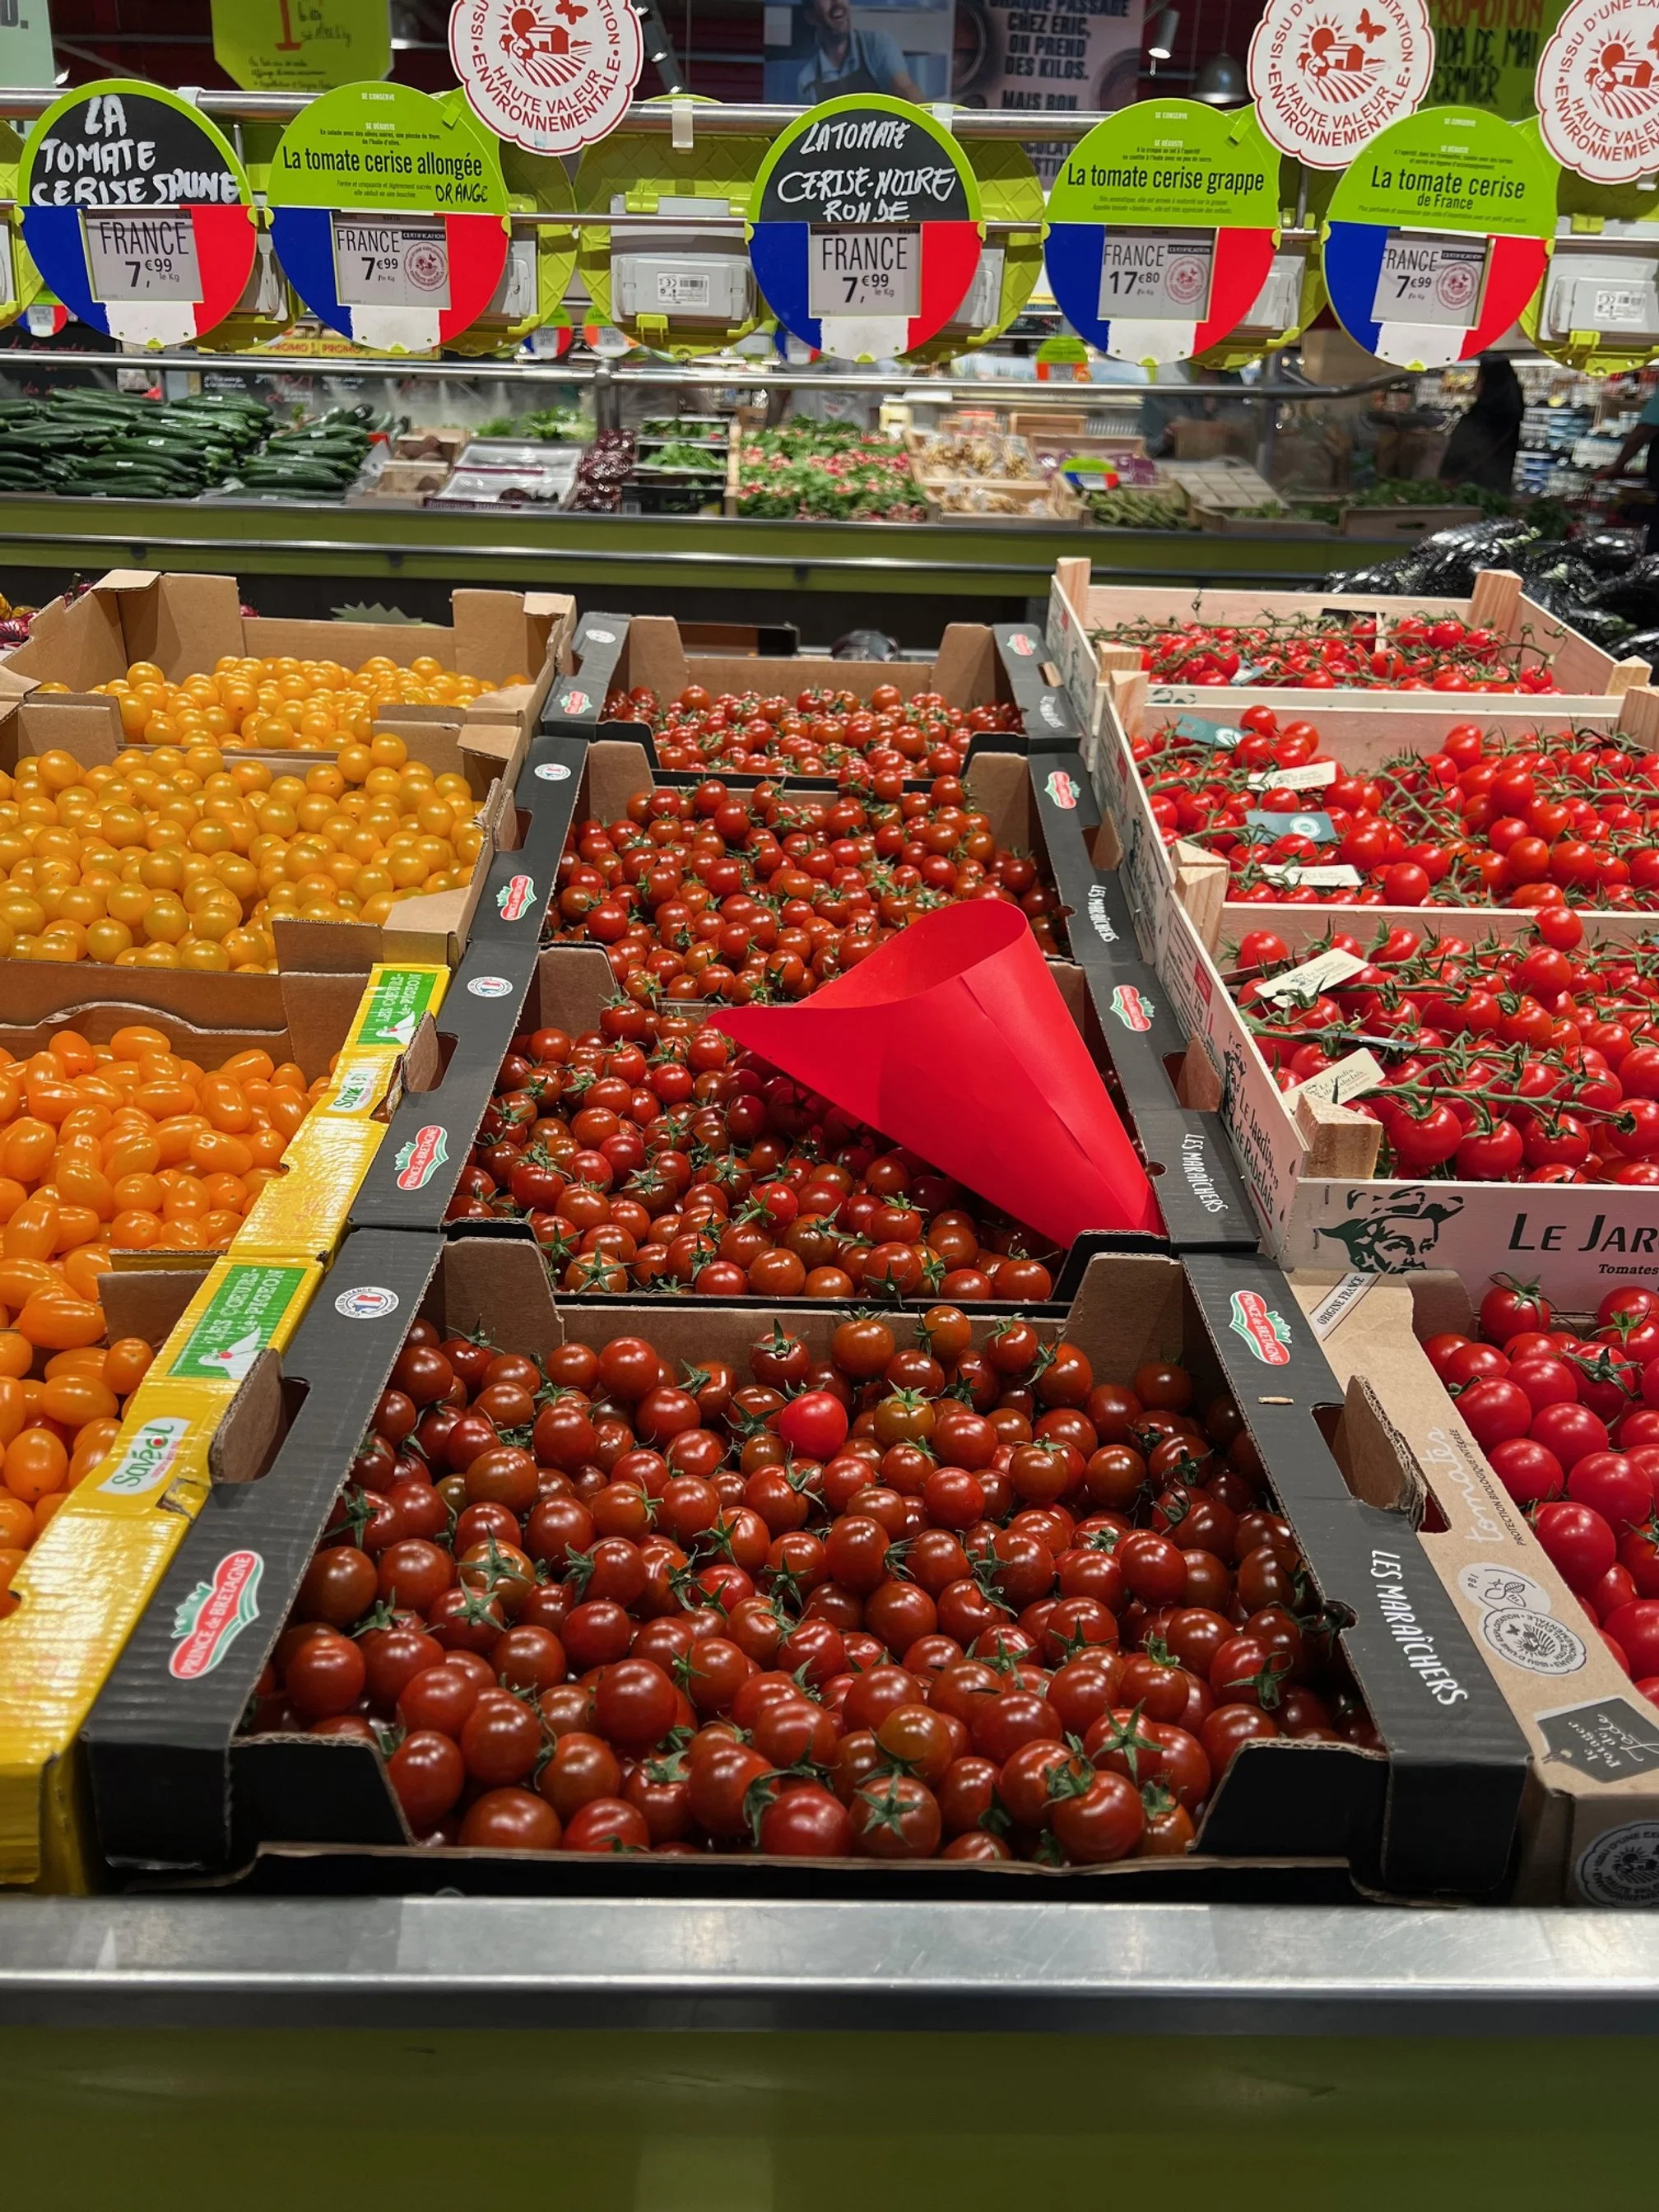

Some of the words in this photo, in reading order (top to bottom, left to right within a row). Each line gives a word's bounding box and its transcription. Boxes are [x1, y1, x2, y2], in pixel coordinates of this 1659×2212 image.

[1007, 12, 1047, 33] CHEZ
[1270, 17, 1293, 58] ISSU
[1010, 35, 1030, 53] ON
[1034, 36, 1086, 58] PREND
[1559, 32, 1585, 73] ISSU
[1006, 56, 1034, 76] DES
[1039, 58, 1089, 79] KILOS.
[472, 53, 621, 132] ENVIRONNEMENTALE
[493, 66, 541, 113] HAUTE
[546, 69, 602, 114] VALEUR
[1002, 91, 1041, 109] MAIS
[1286, 82, 1328, 128] HAUTE
[85, 95, 128, 137] LA
[1268, 71, 1411, 146] ENVIRONNEMENTALE
[1332, 86, 1390, 129] VALEUR
[1572, 97, 1611, 144] HAUTE
[40, 138, 156, 176] TOMATE
[283, 146, 301, 170] La
[305, 148, 360, 171] tomate
[365, 151, 412, 174] cerise
[417, 151, 482, 180] allongée
[32, 177, 147, 206] CERISE
[435, 183, 487, 204] ORANGE
[1067, 163, 1085, 185] La
[1091, 165, 1147, 187] tomate
[1153, 166, 1202, 189] cerise
[1206, 172, 1264, 196] grappe
[1371, 165, 1392, 188] La
[1399, 169, 1462, 194] tomate
[1469, 175, 1525, 199] cerise
[822, 199, 910, 222] RONDE
[1417, 193, 1430, 207] de
[1434, 193, 1473, 211] France
[100, 221, 188, 255] FRANCE
[337, 230, 400, 253] FRANCE
[823, 237, 907, 271] FRANCE
[1104, 244, 1165, 267] FRANCE
[1088, 885, 1107, 898] LES
[1181, 1133, 1205, 1150] LES
[1183, 1152, 1229, 1212] MARAÎCHERS
[1598, 1263, 1659, 1276] Tomates
[1317, 1299, 1345, 1325] ORIGINE
[1337, 1276, 1365, 1300] FRANCE
[203, 1319, 234, 1344] LES
[1241, 1293, 1262, 1317] PRINCE
[1255, 1325, 1283, 1362] BRETAGNE
[112, 1424, 174, 1488] Savéol
[1420, 1426, 1504, 1543] tomates
[1470, 1460, 1497, 1500] BIOLOGIQUE
[1492, 1498, 1527, 1546] PROTECTION
[1370, 1550, 1403, 1580] LES
[1467, 1573, 1479, 1589] PBI
[208, 1556, 253, 1616] BRETAGNE
[205, 1617, 222, 1630] de
[179, 1629, 216, 1675] PRINCE
[1376, 1584, 1468, 1705] MARAÎCHERS
[1568, 1722, 1622, 1768] Potager
[1584, 1749, 1598, 1761] le
[1598, 1732, 1616, 1745] de
